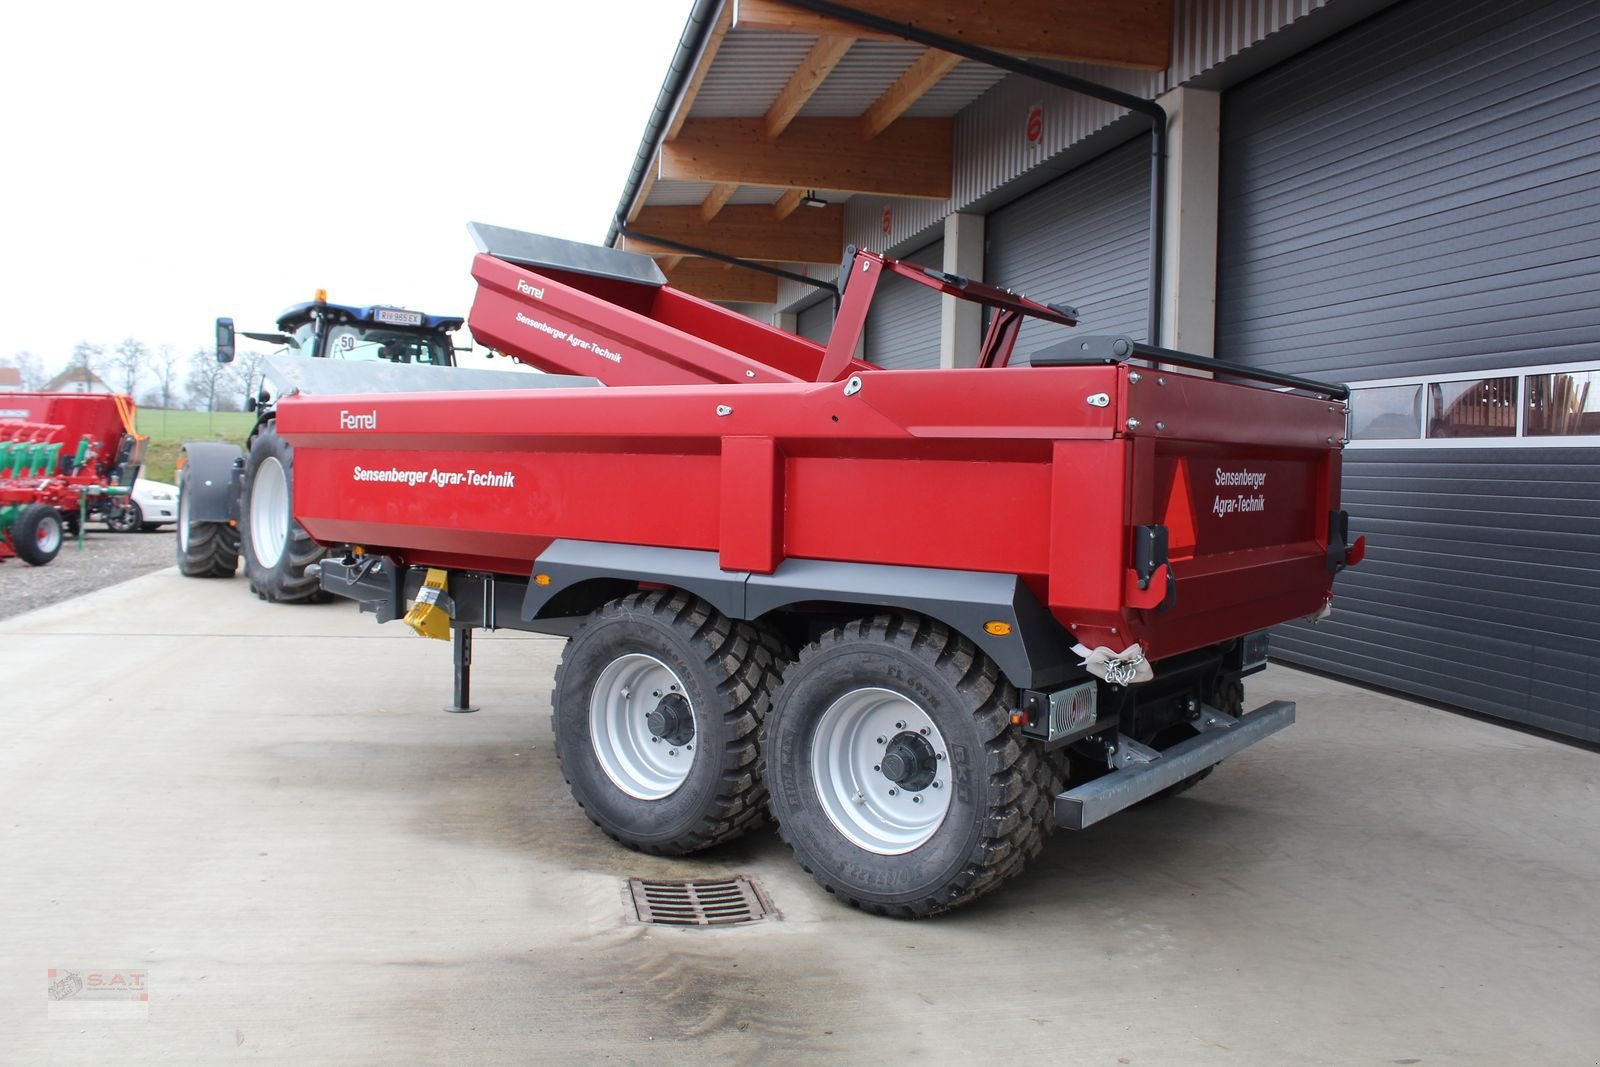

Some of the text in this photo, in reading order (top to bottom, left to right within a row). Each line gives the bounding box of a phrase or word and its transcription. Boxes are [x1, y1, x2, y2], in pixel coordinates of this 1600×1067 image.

[1027, 107, 1042, 142] 6
[517, 279, 545, 300] Ferrel
[341, 337, 354, 349] 50
[515, 312, 622, 364] Sensenberger Agrar-Technik
[339, 409, 377, 431] Ferrel
[353, 466, 516, 489] Sensenberger Agrar-Technik
[1213, 467, 1266, 518] Sensenberger Agrar-Technik
